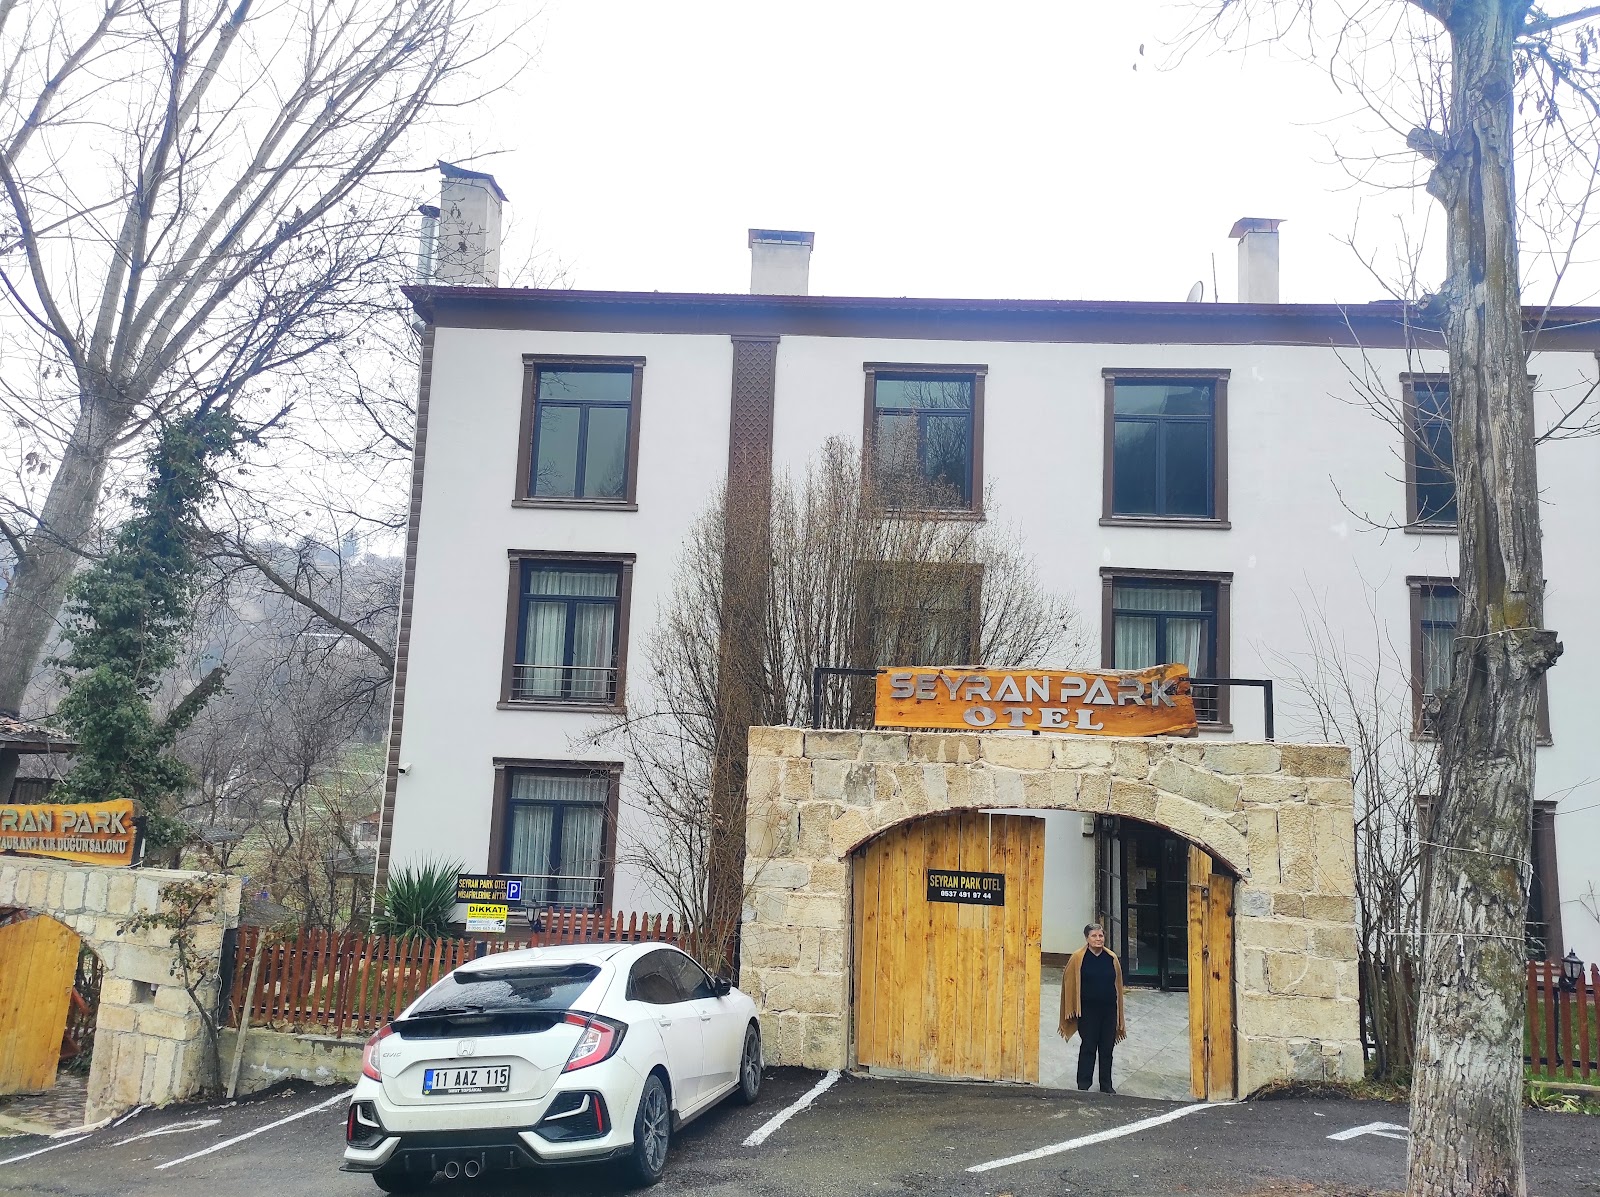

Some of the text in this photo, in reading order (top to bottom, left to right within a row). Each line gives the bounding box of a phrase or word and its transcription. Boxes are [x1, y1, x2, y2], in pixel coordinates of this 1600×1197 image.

[890, 673, 1178, 708] SEYRAN PARK
[963, 706, 1104, 731] OTEL
[0, 809, 127, 834] RAN PARK
[0, 835, 39, 850] AURANT
[458, 879, 507, 890] SEYRAN PARK OTEL
[510, 883, 518, 898] P
[929, 875, 1001, 891] SEYRAN PARK OTEL
[469, 905, 506, 913] DİKKAT!
[435, 1068, 508, 1087] 11 AAZ 115
